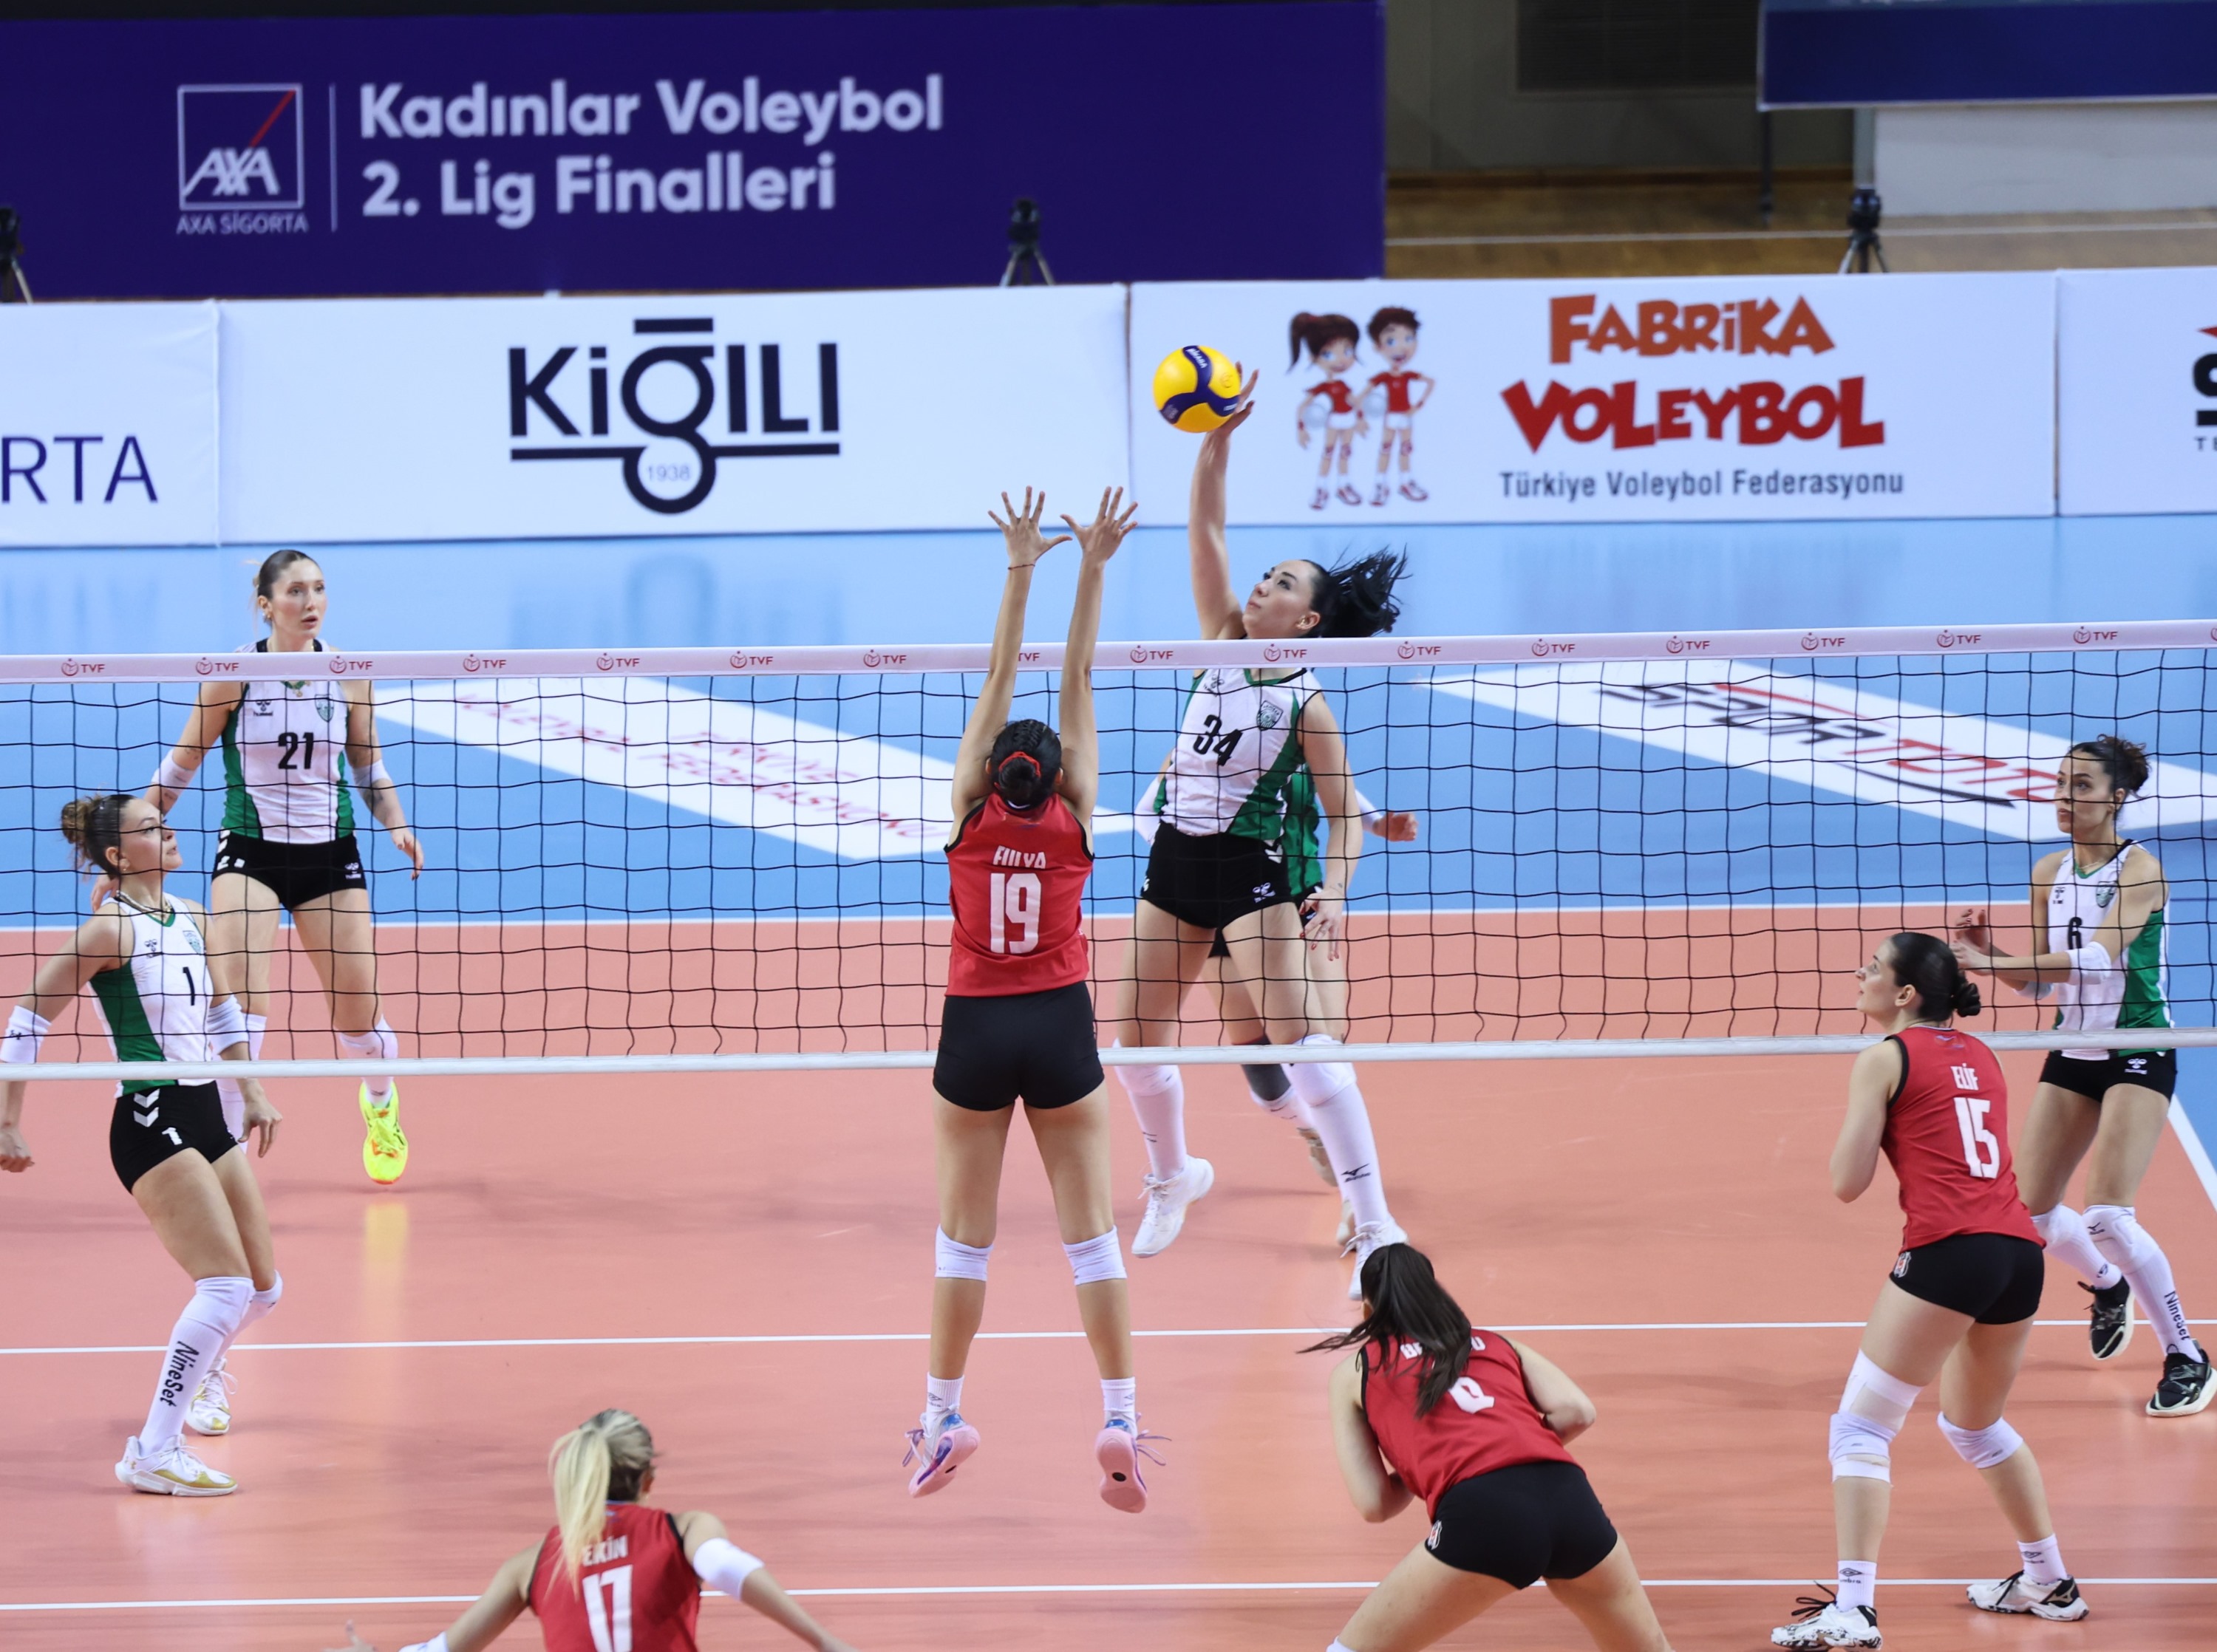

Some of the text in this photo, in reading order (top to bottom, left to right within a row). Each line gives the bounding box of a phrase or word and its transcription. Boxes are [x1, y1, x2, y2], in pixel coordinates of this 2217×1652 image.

[360, 73, 943, 146] Kadınlar Voleybol
[182, 147, 281, 197] AXA
[361, 151, 836, 230] 2. Lig Finalleri
[176, 213, 217, 235] AXA
[1499, 375, 1885, 454] VOLEYBOL
[0, 434, 158, 504] RTA
[647, 463, 692, 482] 1938
[1499, 469, 1904, 503] Türkiye Voleybol Federasyonu
[1685, 641, 1710, 650] TVF
[1820, 638, 1845, 647] TVF
[1955, 635, 1981, 644] TVF
[2092, 631, 2117, 641] TVF
[1148, 650, 1174, 660] TVF
[1282, 649, 1307, 658] TVF
[1416, 646, 1441, 655] TVF
[1550, 644, 1575, 653] TVF
[81, 663, 106, 672] TVF
[214, 662, 239, 672] TVF
[347, 661, 372, 670] TVF
[481, 659, 506, 669] TVF
[615, 658, 640, 667] TVF
[749, 656, 774, 666] TVF
[882, 655, 907, 664] TVF
[1192, 714, 1243, 767] 34
[277, 731, 314, 770] 21
[990, 873, 1042, 954] 19
[183, 966, 195, 1006] 1
[162, 1126, 183, 1145] 1
[1953, 1096, 2000, 1180] 15
[160, 1340, 200, 1407] NineSet
[582, 1564, 633, 1652] 17
